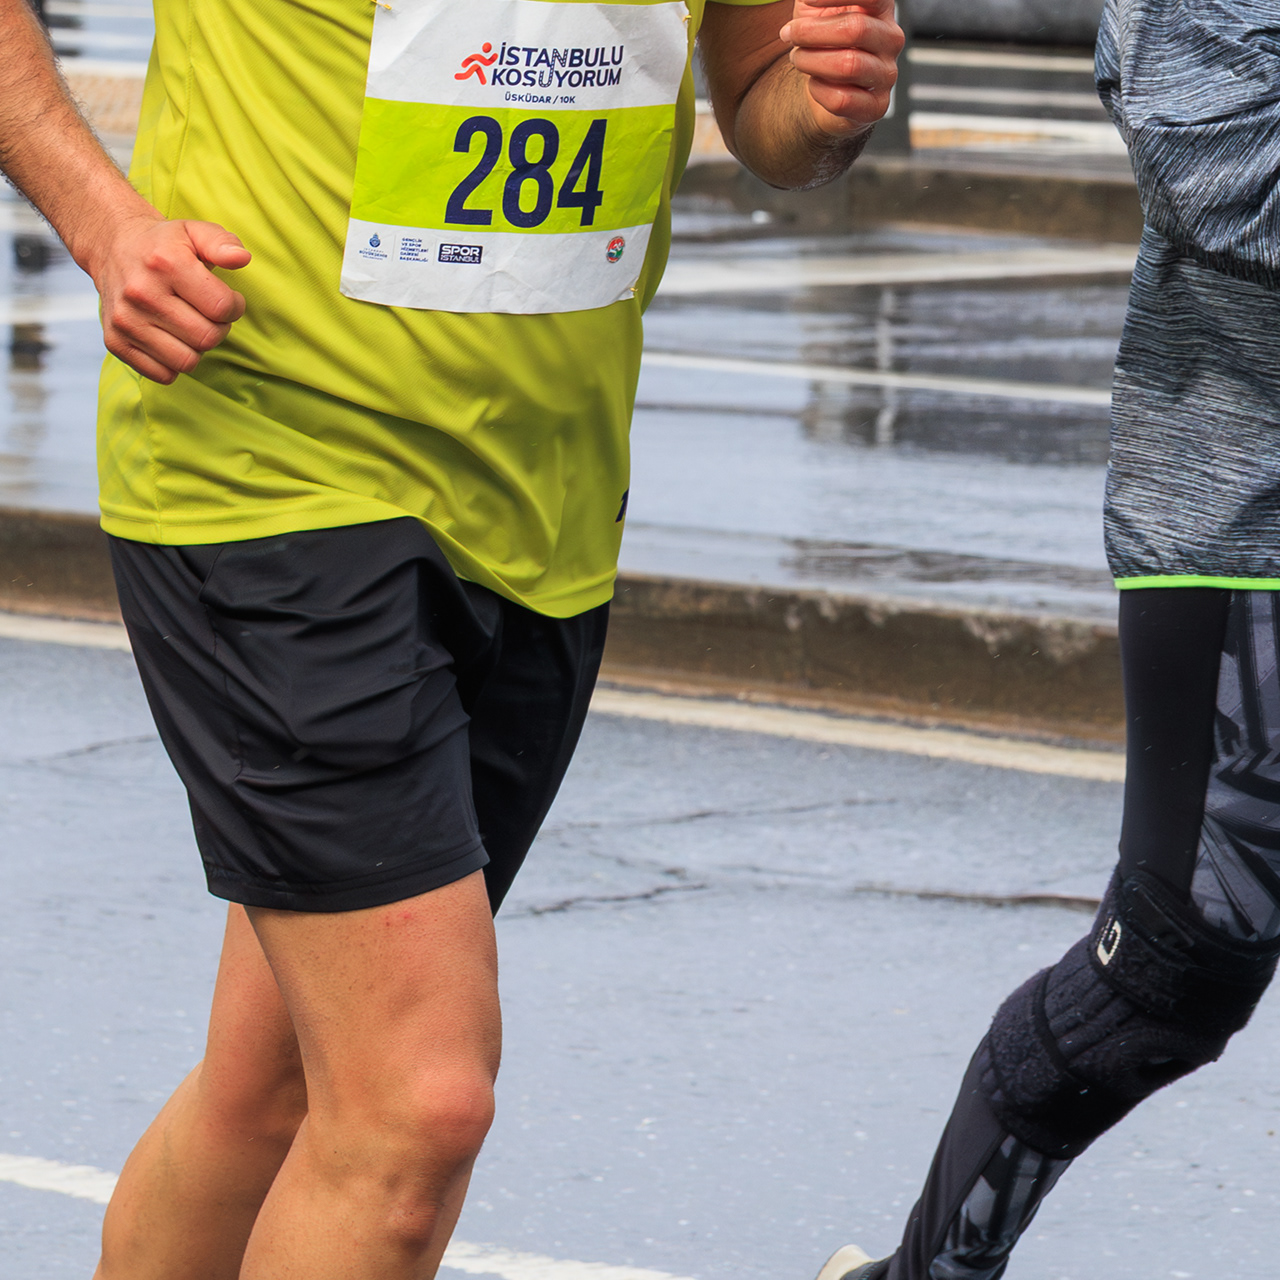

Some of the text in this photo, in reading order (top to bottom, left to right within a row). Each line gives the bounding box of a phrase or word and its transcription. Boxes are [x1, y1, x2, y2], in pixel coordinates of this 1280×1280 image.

[498, 42, 624, 70] İSTANBULU
[491, 67, 622, 88] KOŞUYORUM
[505, 91, 551, 104] ÜSKÜDAR
[560, 96, 576, 104] 10K
[444, 115, 608, 229] 284
[441, 245, 480, 257] SPOR
